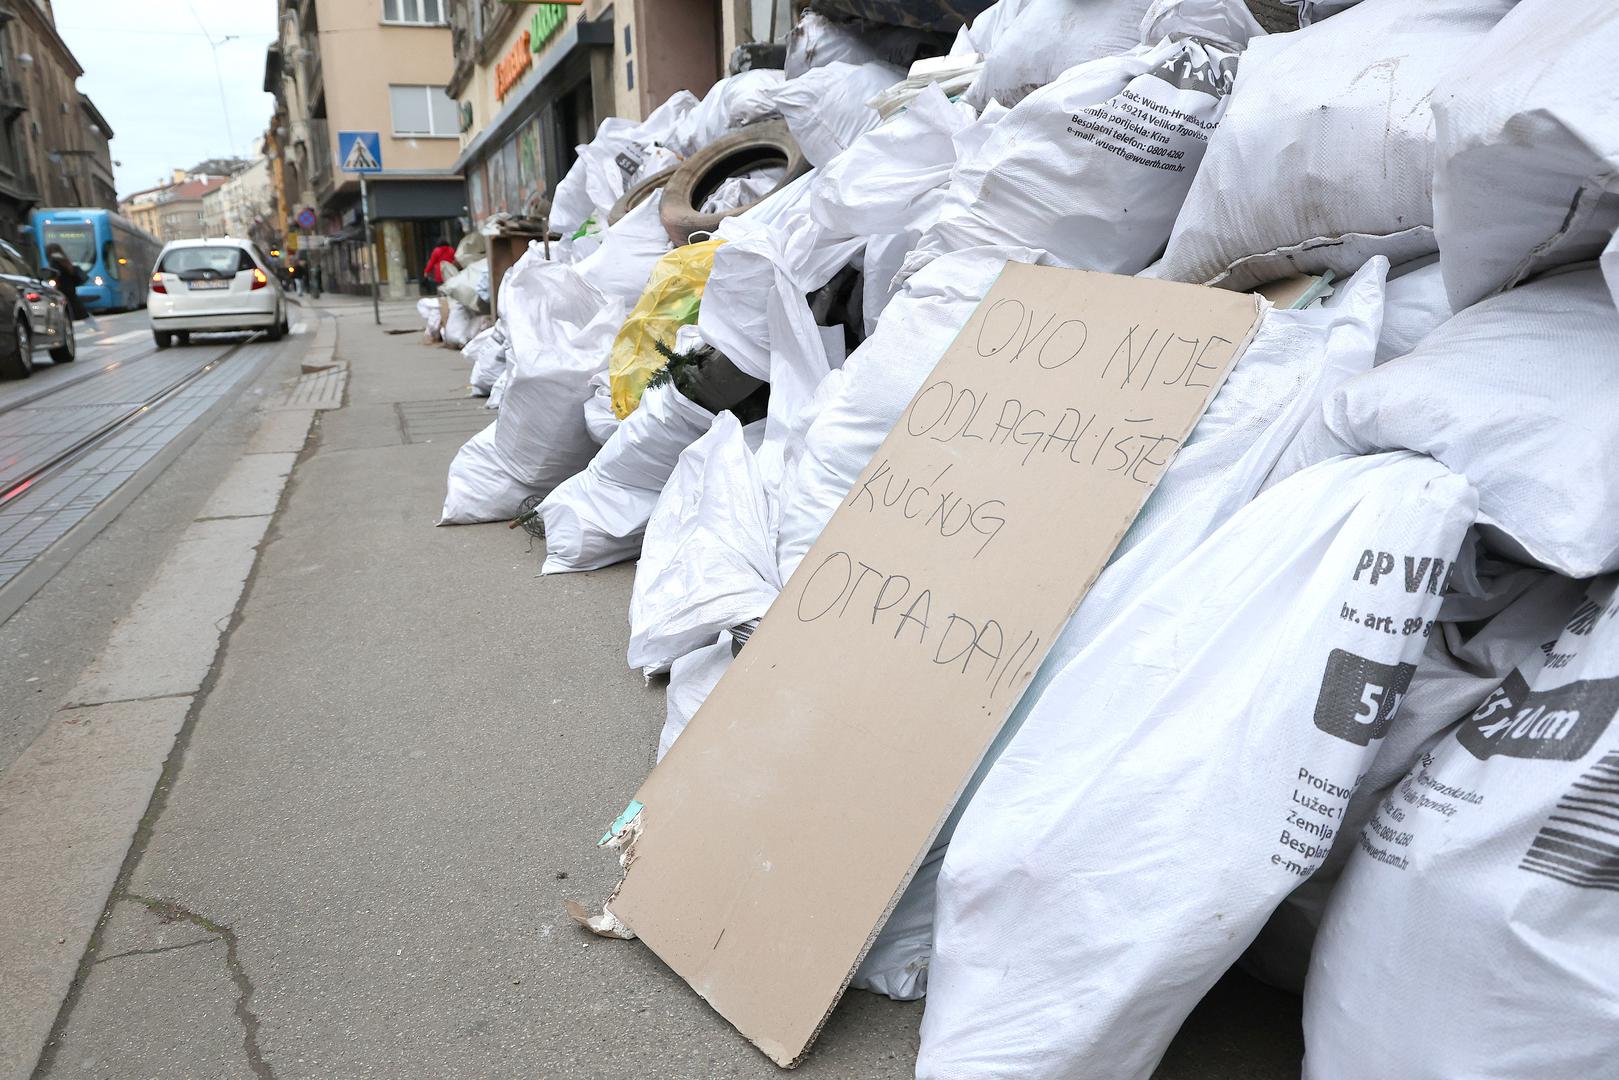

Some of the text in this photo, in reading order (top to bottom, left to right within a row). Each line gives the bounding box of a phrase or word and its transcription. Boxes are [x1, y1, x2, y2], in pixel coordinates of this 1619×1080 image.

[1108, 115, 1150, 137] porijekla:
[1150, 130, 1171, 144] Kina
[1120, 103, 1148, 121] 49214
[1149, 114, 1176, 131] Veliko
[1067, 126, 1187, 173] e-mail: wuerth@wuerth.com.hr
[1071, 113, 1186, 160] Besplatni telefon: 0800 4260
[975, 298, 1232, 390] OVO NIJE
[1352, 549, 1395, 585] PP
[1340, 601, 1360, 624] br.
[1364, 613, 1397, 635] art.
[1402, 616, 1424, 636] 89
[1292, 788, 1335, 818] Lužec
[1286, 809, 1334, 841] Zemlja
